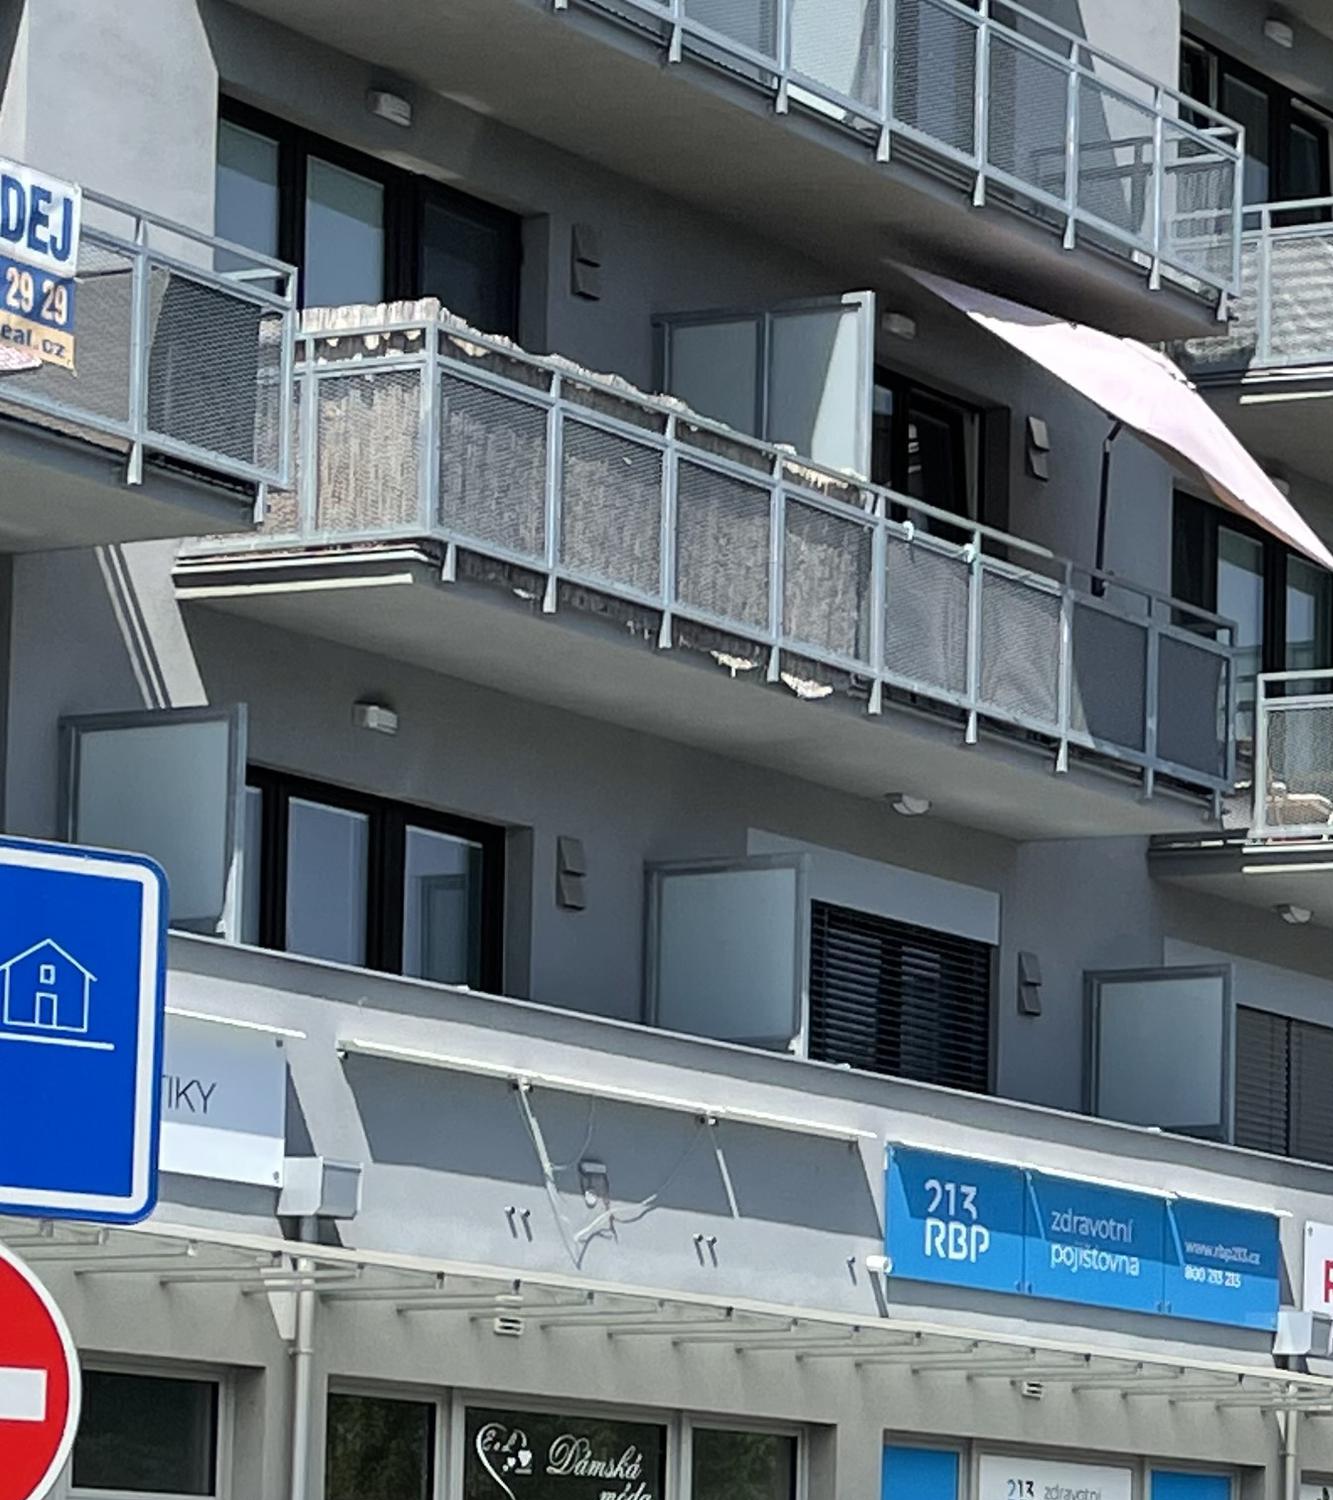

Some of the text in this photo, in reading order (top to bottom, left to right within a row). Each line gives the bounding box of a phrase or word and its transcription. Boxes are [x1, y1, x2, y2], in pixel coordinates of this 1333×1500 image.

[5, 266, 68, 326] 29 29
[924, 1179, 979, 1220] 213
[924, 1218, 991, 1264] RBP
[1050, 1208, 1134, 1243] zdravotní
[546, 1434, 643, 1482] Dámská
